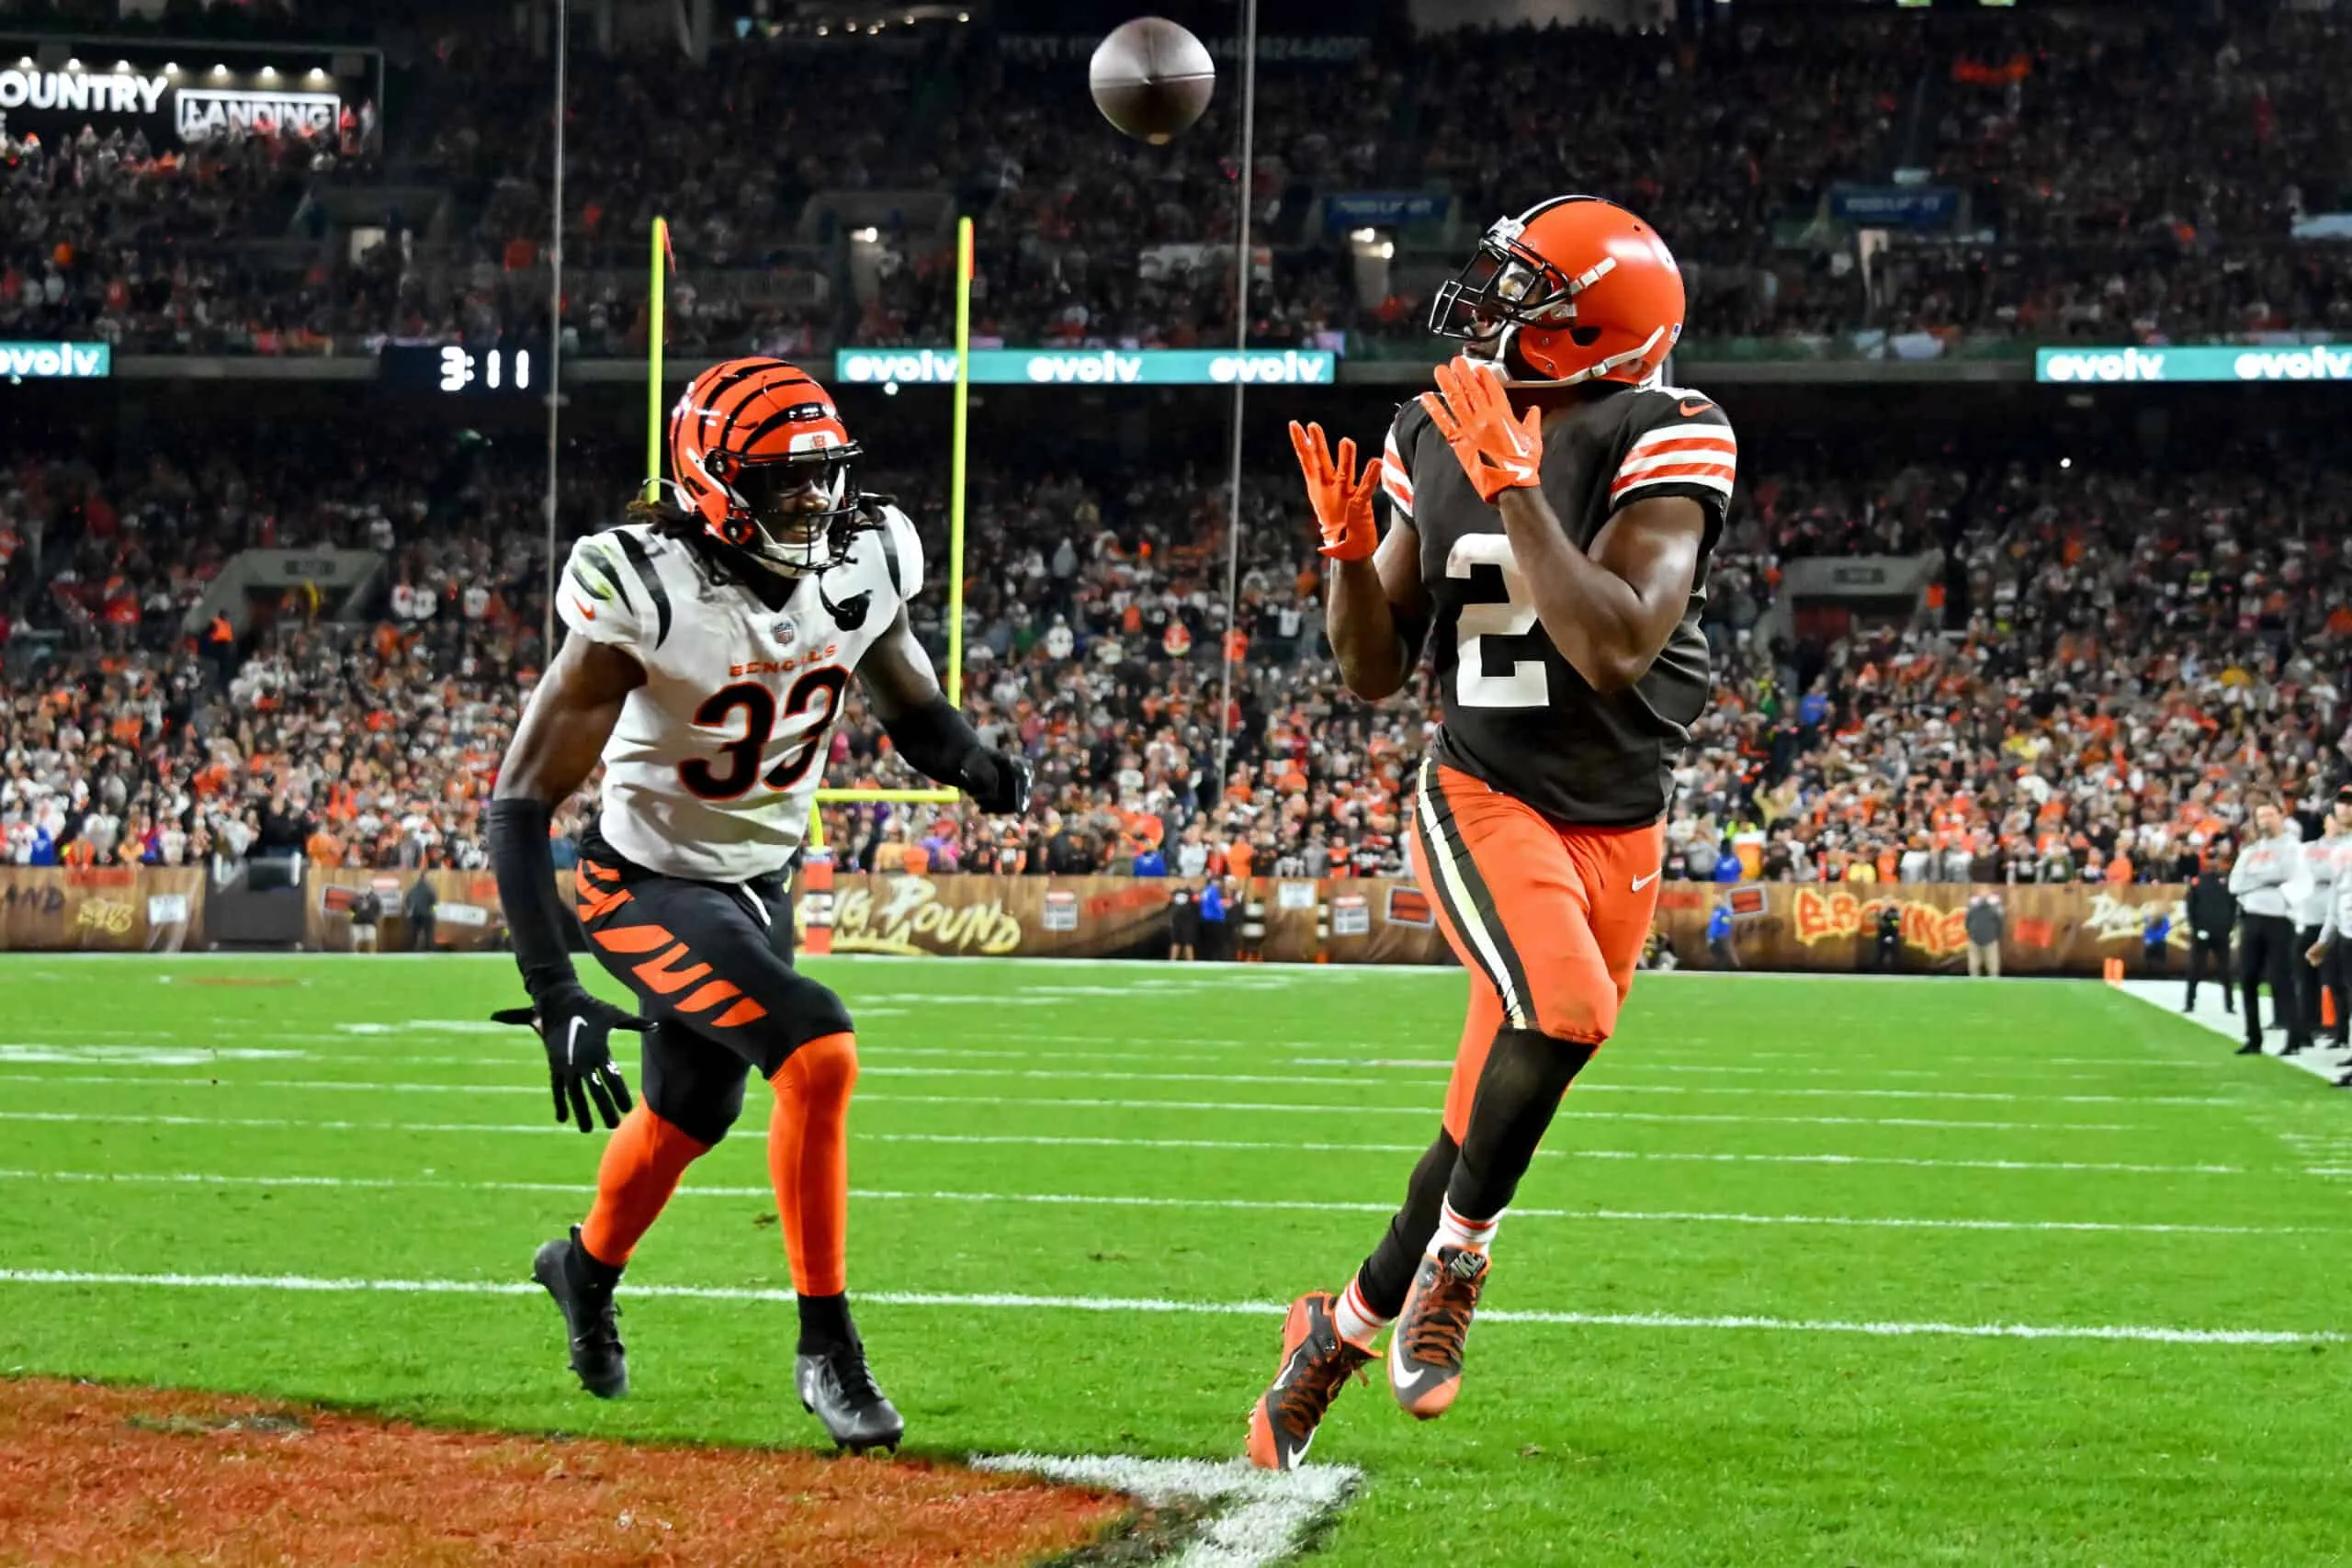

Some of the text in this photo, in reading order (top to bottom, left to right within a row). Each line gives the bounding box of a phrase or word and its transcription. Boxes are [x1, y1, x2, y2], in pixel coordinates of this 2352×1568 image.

[184, 100, 332, 140] LANDING
[441, 345, 530, 391] 3:11
[846, 349, 958, 382] evolv
[1026, 350, 1142, 383] evolv
[1208, 350, 1324, 383] evolv
[2046, 347, 2165, 380] evolv
[2233, 345, 2352, 379] evolv
[1446, 533, 1550, 707] 2
[677, 662, 850, 802] 33
